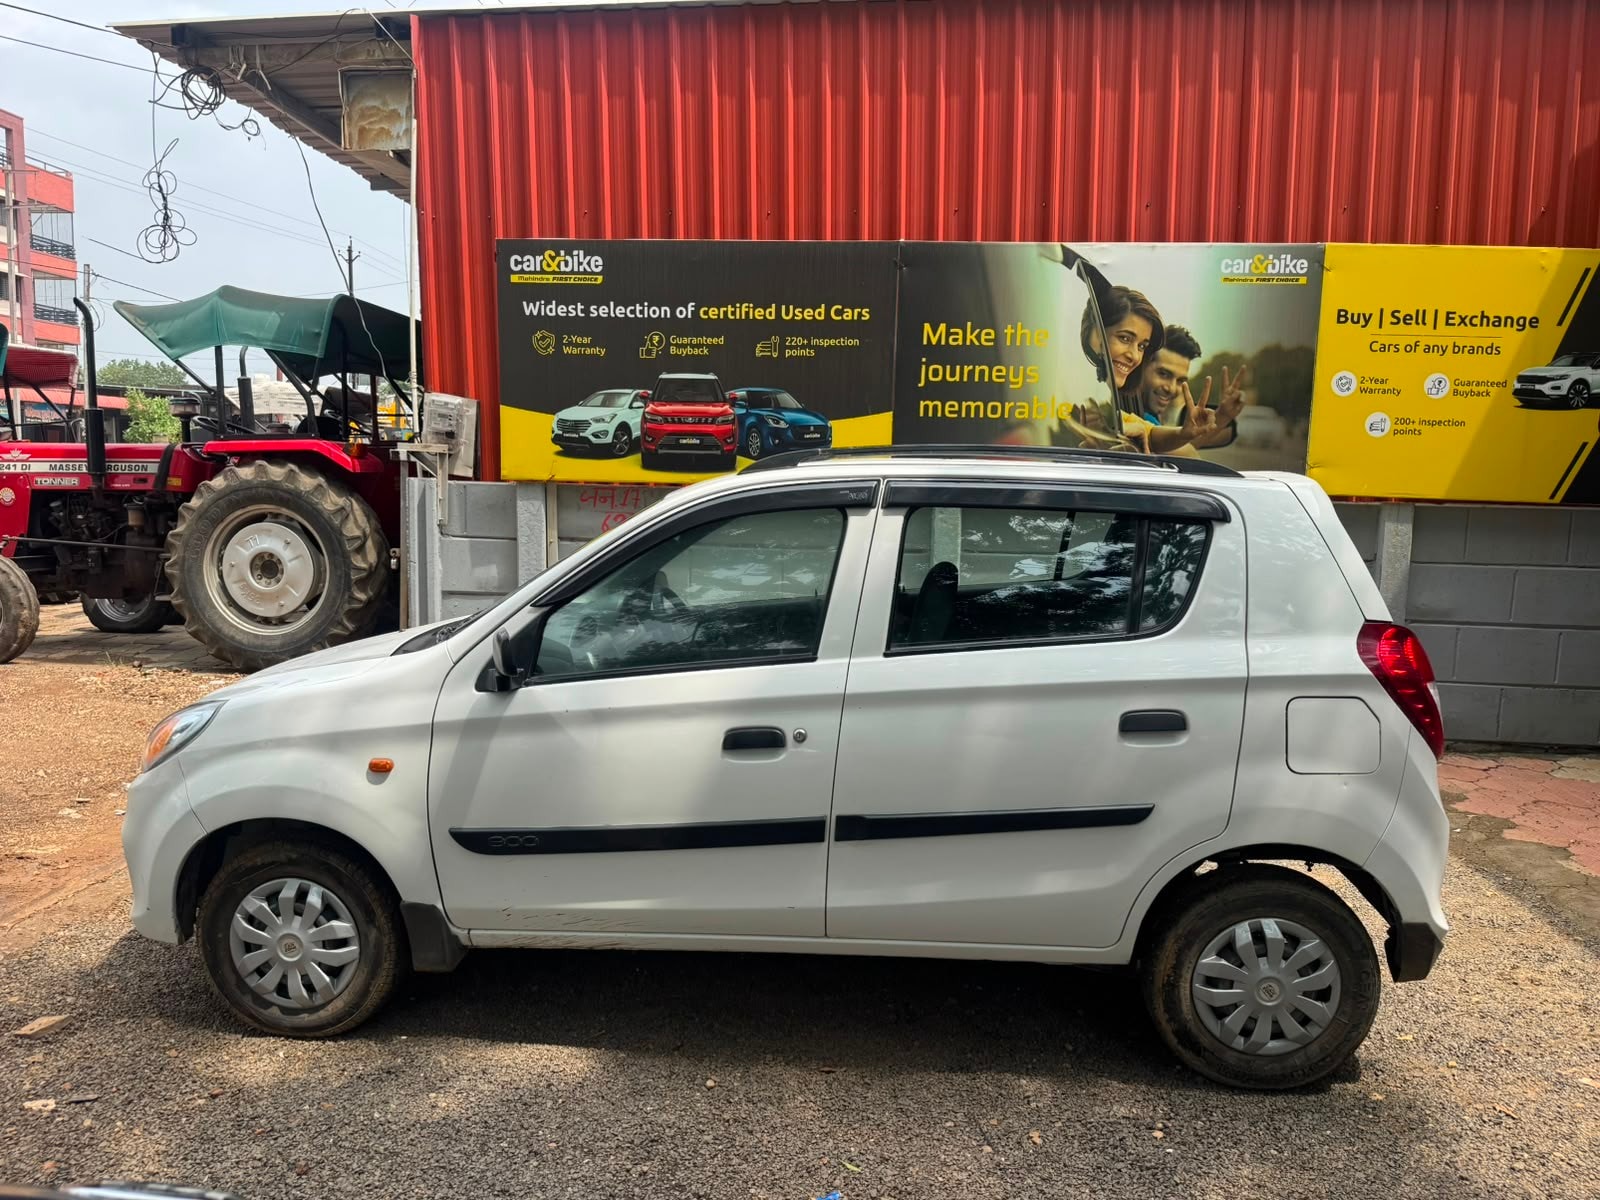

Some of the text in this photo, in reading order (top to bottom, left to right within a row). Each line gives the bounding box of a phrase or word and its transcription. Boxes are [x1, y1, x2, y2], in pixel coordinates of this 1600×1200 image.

[509, 249, 604, 273] car&bike
[1220, 253, 1309, 274] car&bike
[522, 299, 871, 321] Widest selection of certified Used Cars
[1335, 308, 1374, 329] Buy
[1389, 308, 1428, 327] Sell
[1444, 310, 1541, 332] Exchange
[562, 334, 593, 344] 2-Year
[669, 335, 725, 345] Guaranteed
[922, 321, 1050, 347] Make the
[785, 336, 860, 349] 220+ inspection
[1369, 340, 1502, 357] Cars of any brands
[562, 345, 607, 357] Warranty
[669, 345, 710, 357] Buyback
[785, 347, 816, 359] points
[917, 357, 1041, 390] journeys
[1359, 376, 1390, 386] 2-Year
[1453, 378, 1508, 389] Guaranteed
[1359, 386, 1402, 398] Warranty
[1452, 388, 1492, 399] Buyback
[918, 394, 1074, 420] memorable
[1393, 417, 1467, 429] 200+ inspection
[1392, 427, 1423, 438] points
[20, 463, 32, 472] DI
[105, 463, 149, 472] RGUSON
